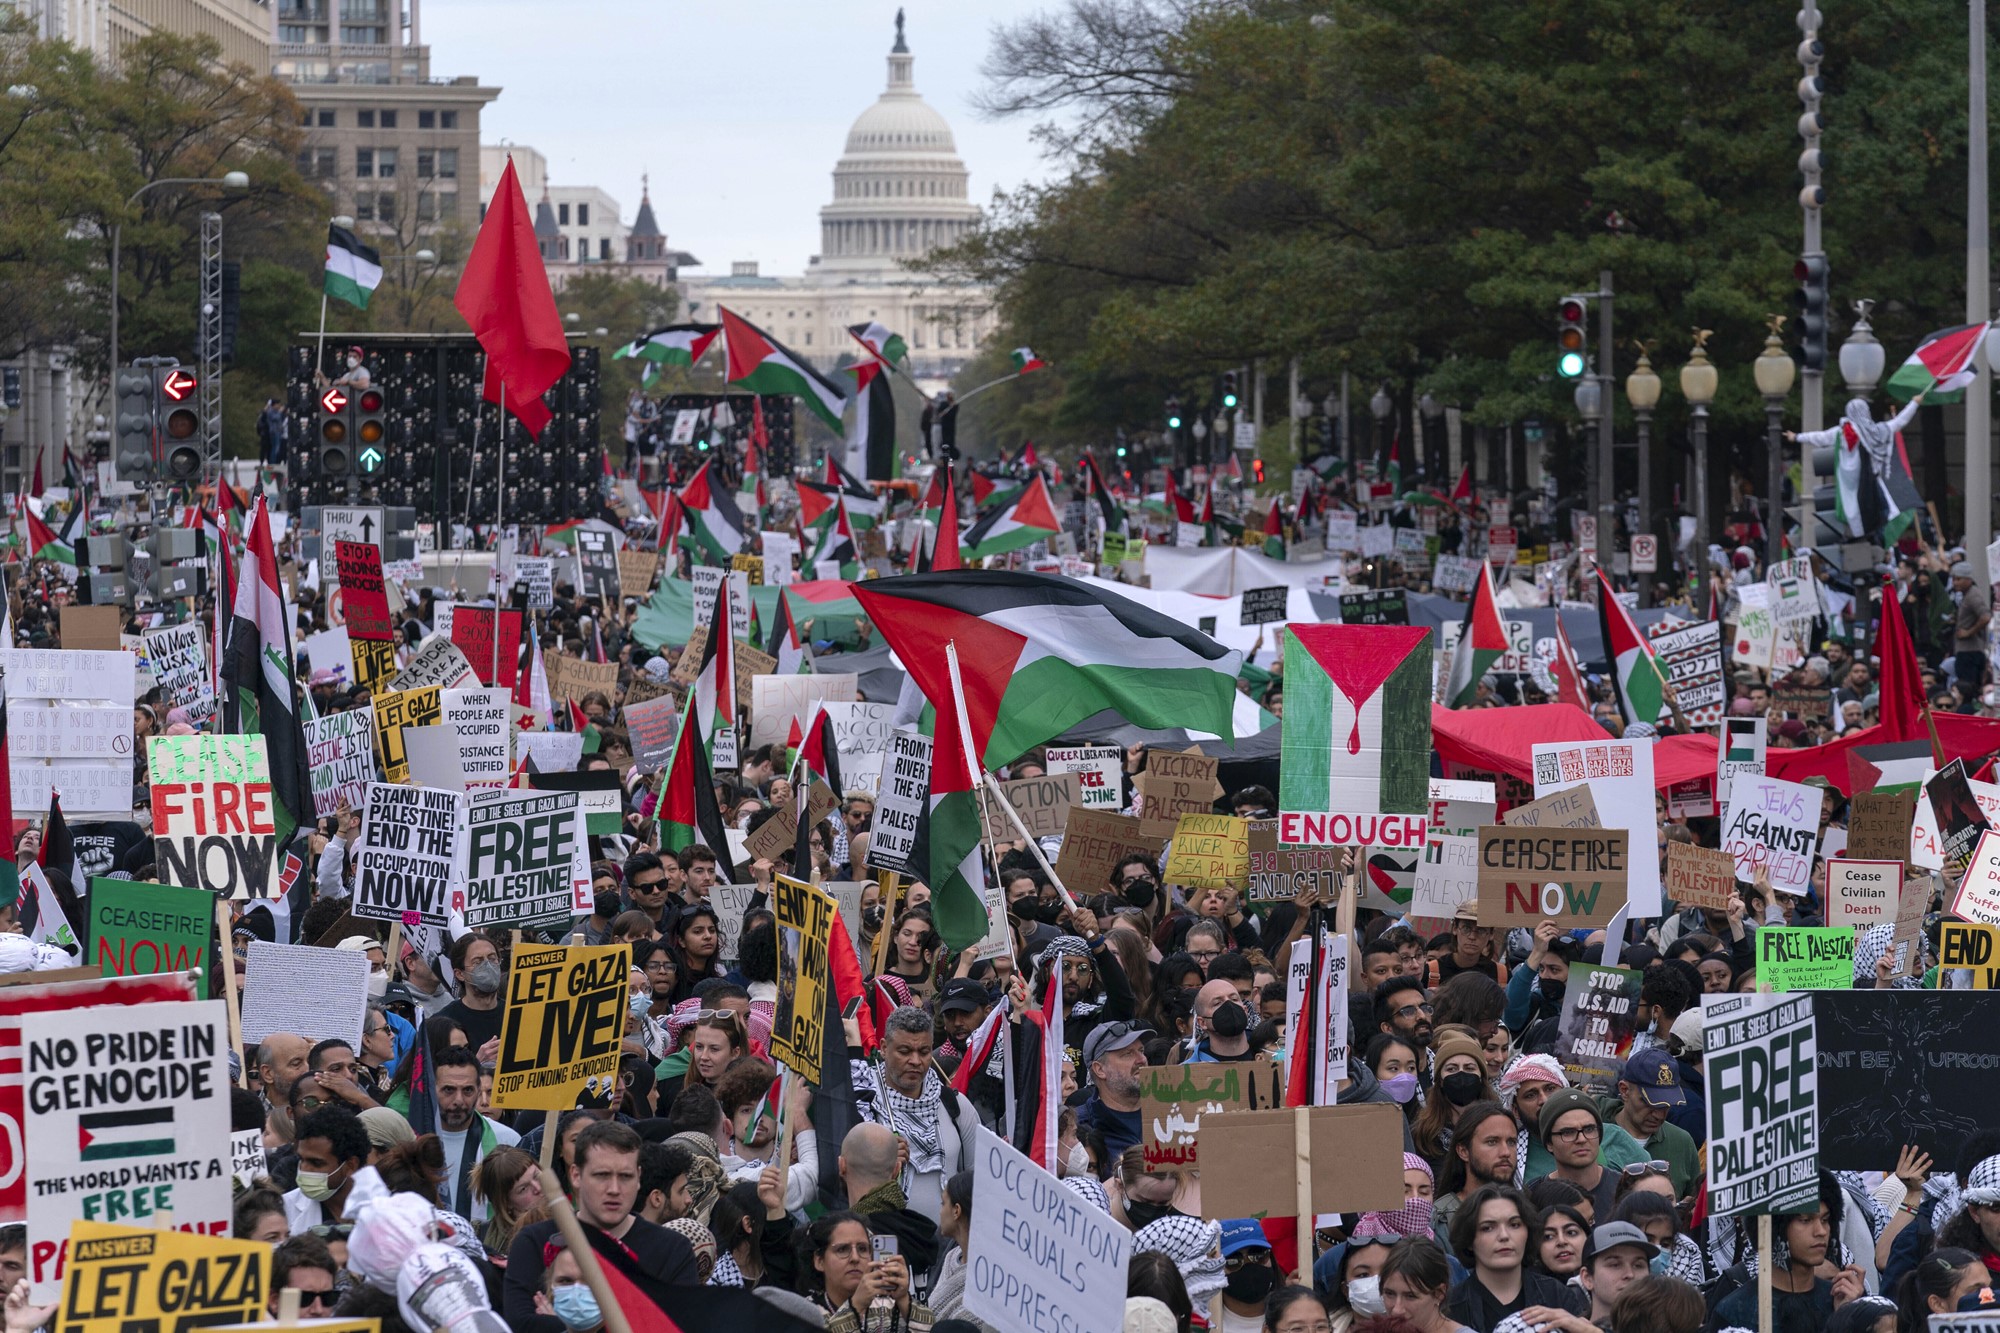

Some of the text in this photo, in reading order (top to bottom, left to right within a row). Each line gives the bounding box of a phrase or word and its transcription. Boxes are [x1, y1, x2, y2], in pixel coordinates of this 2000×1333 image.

[326, 512, 353, 524] THRU
[343, 544, 372, 558] STOP
[337, 559, 382, 577] FUNDING
[696, 572, 718, 580] STOP
[338, 576, 383, 593] GENOCIDE
[1740, 611, 1769, 628] WAKE
[147, 630, 198, 660] NO More
[352, 643, 368, 660] LET
[160, 652, 192, 672] USA
[198, 660, 208, 682] 4
[394, 667, 423, 690] JOE
[417, 639, 452, 668] BIDEN
[427, 660, 447, 684] ARE
[448, 654, 458, 665] A
[570, 660, 617, 684] GENOCIDE
[1670, 657, 1708, 680] לכיבו
[26, 676, 73, 693] NOW!
[764, 678, 854, 708] END THE
[1680, 684, 1720, 701] WITH THE
[377, 694, 403, 710] ANSWER
[378, 688, 441, 730] LET GAZA
[462, 694, 490, 706] WHEN
[24, 712, 127, 728] SAY NO TO
[448, 709, 504, 721] PEOPLE ARE
[851, 704, 884, 720] NO
[320, 711, 352, 742] STAND
[70, 736, 107, 752] JOE
[894, 736, 926, 757] FROM
[150, 734, 270, 784] CEASE
[1047, 749, 1120, 762] QUEER LIBERATION
[1588, 760, 1609, 769] GAZA
[1612, 759, 1632, 768] GAZA
[894, 756, 926, 780] RIVER
[1150, 756, 1215, 780] VICTORY
[1538, 770, 1560, 784] GAZA
[1562, 763, 1583, 774] GAZA
[1564, 771, 1586, 782] DIES
[1589, 768, 1610, 778] DIES
[1612, 767, 1632, 776] DIES
[88, 770, 132, 788] KIDS
[894, 777, 914, 798] THE
[1174, 782, 1190, 797] TO
[371, 786, 456, 812] STAND WITH
[474, 792, 500, 802] ANSWER
[1548, 794, 1582, 816] THE
[1757, 785, 1805, 822] JEWS
[369, 804, 455, 832] PALESTINE!
[472, 794, 577, 823] END THE SIEGE ON GAZA NOW!
[1855, 800, 1882, 816] WHAT
[1182, 816, 1231, 834] FROM
[1281, 813, 1427, 846] ENOUGH
[1727, 808, 1816, 856] AGAINST
[1852, 816, 1905, 834] PALESTINE
[74, 836, 115, 848] FREE
[366, 822, 454, 858] END THE
[469, 810, 575, 880] FREE
[876, 832, 898, 851] WILL
[1178, 837, 1223, 854] RIVER
[1851, 837, 1885, 848] WAS THE
[155, 835, 276, 900] NOW
[363, 852, 450, 880] OCCUPATION
[1174, 857, 1201, 874] SEA
[1670, 857, 1722, 876] TO THE SEA
[1846, 870, 1882, 882] Cease
[360, 868, 447, 916] NOW!
[468, 865, 571, 908] PALESTINE!
[1670, 888, 1710, 904] WILL BE
[1841, 886, 1886, 898] Civilian
[777, 880, 808, 928] END
[1505, 882, 1602, 916] NOW
[1845, 903, 1882, 914] Death
[366, 908, 447, 924] Party Liberation
[468, 895, 570, 925] END ALL U.S. AID TO ISRAEL
[100, 906, 204, 936] CEASEFIRE
[1852, 922, 1874, 932] and
[98, 935, 202, 976] NOW
[1763, 932, 1808, 963] FREE
[1944, 928, 1992, 966] END
[518, 951, 564, 968] ANSWER
[510, 950, 627, 1006] LET GAZA
[1588, 970, 1624, 990] STOP
[1787, 973, 1824, 982] WALLS!
[1790, 978, 1827, 988] BORDERS!
[1578, 992, 1630, 1014] U.S. AID
[1708, 1000, 1741, 1017] ANSWER
[500, 984, 626, 1074] LIVE!
[1591, 1018, 1610, 1035] TO
[1708, 1004, 1796, 1051] END THE SIEGE GAZA
[29, 1023, 216, 1072] NO PRIDE IN
[1571, 1038, 1618, 1060] ISRAEL
[1861, 1050, 1890, 1069] BE
[498, 1054, 618, 1094] STOP FUNDING GENOCIDE!
[1708, 1024, 1815, 1142] FREE
[29, 1060, 214, 1115] GENOCIDE
[1712, 1109, 1815, 1184] PALESTINE!
[34, 1158, 222, 1196] THE WORLD WANTS A
[1714, 1156, 1818, 1212] END ALL U.S. TO ISRAEL
[82, 1184, 174, 1222] FREE
[990, 1146, 1120, 1268] OCCUPATION
[1224, 1229, 1238, 1238] Doing
[78, 1236, 153, 1260] ANSWER
[1002, 1208, 1087, 1293] EQUALS
[66, 1252, 262, 1321] LET GAZA
